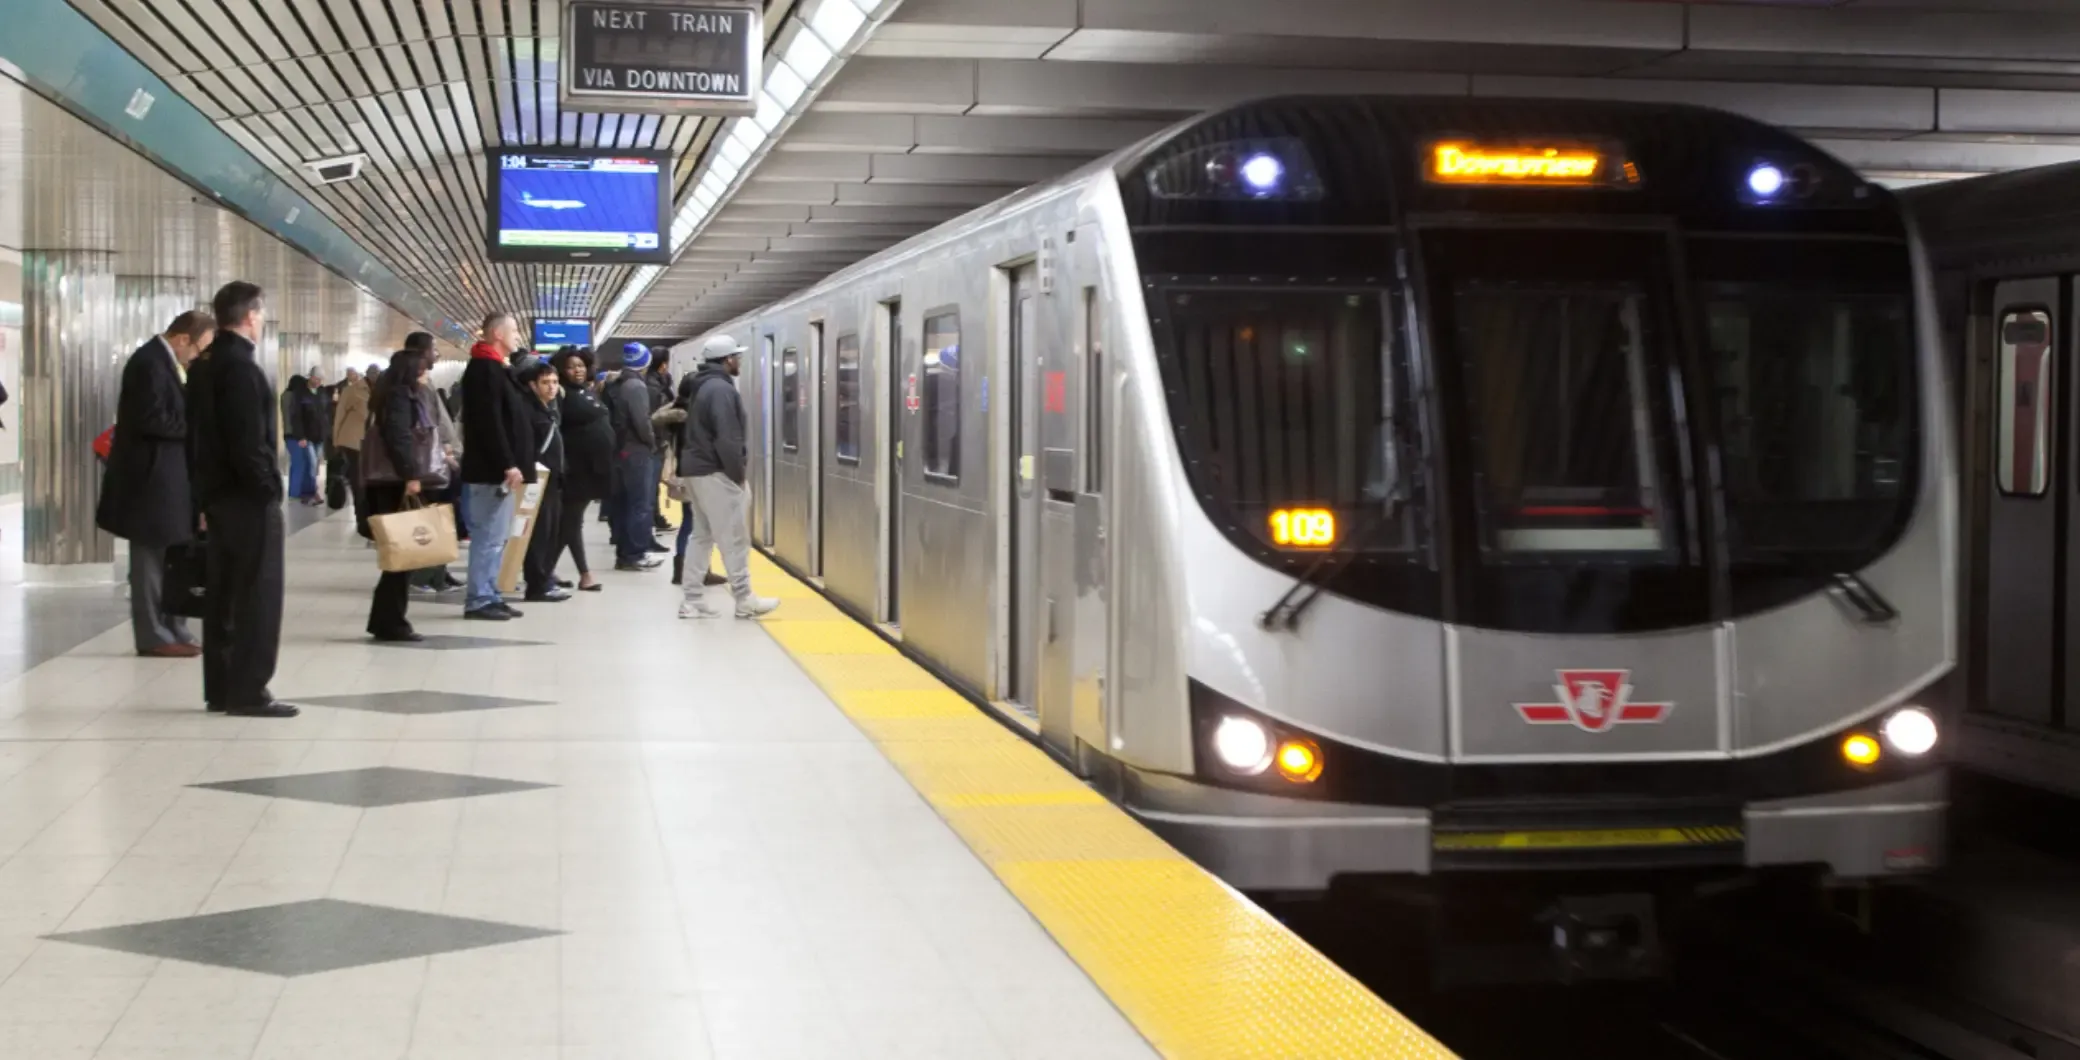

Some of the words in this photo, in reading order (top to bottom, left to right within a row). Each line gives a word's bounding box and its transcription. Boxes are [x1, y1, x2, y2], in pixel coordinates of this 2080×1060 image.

[592, 9, 648, 30] NEXT
[669, 12, 733, 34] TRAIN
[583, 67, 616, 88] VIA
[626, 69, 740, 93] DOWNTOWN
[500, 155, 527, 169] 1:04
[1269, 507, 1334, 546] 109
